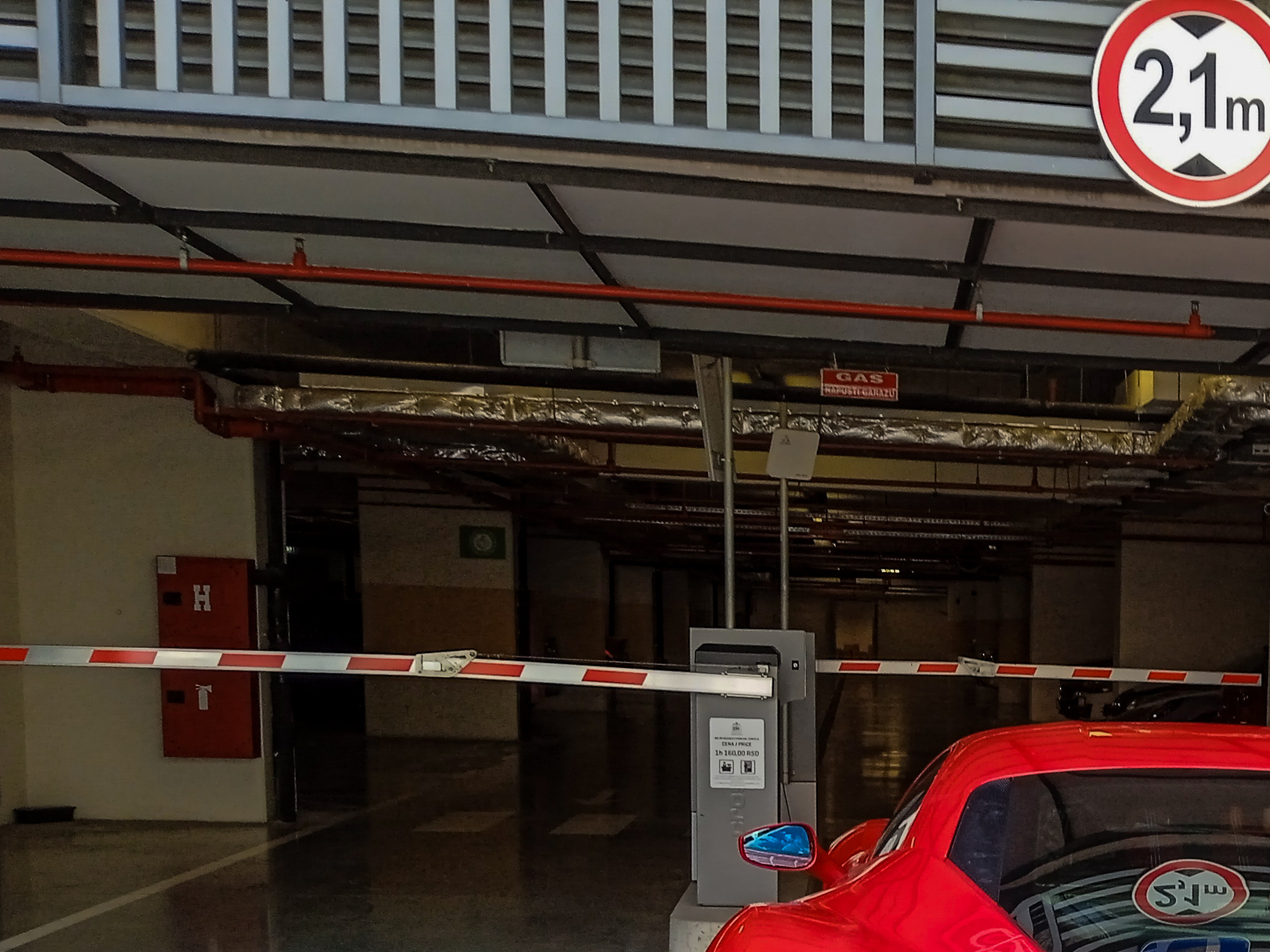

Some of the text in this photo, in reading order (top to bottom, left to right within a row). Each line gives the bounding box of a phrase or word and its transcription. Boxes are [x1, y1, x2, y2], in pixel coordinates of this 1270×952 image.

[1132, 48, 1266, 143] 2,1m
[835, 372, 884, 384] GAS
[824, 385, 860, 396] NAPUSTI
[193, 584, 211, 612] H
